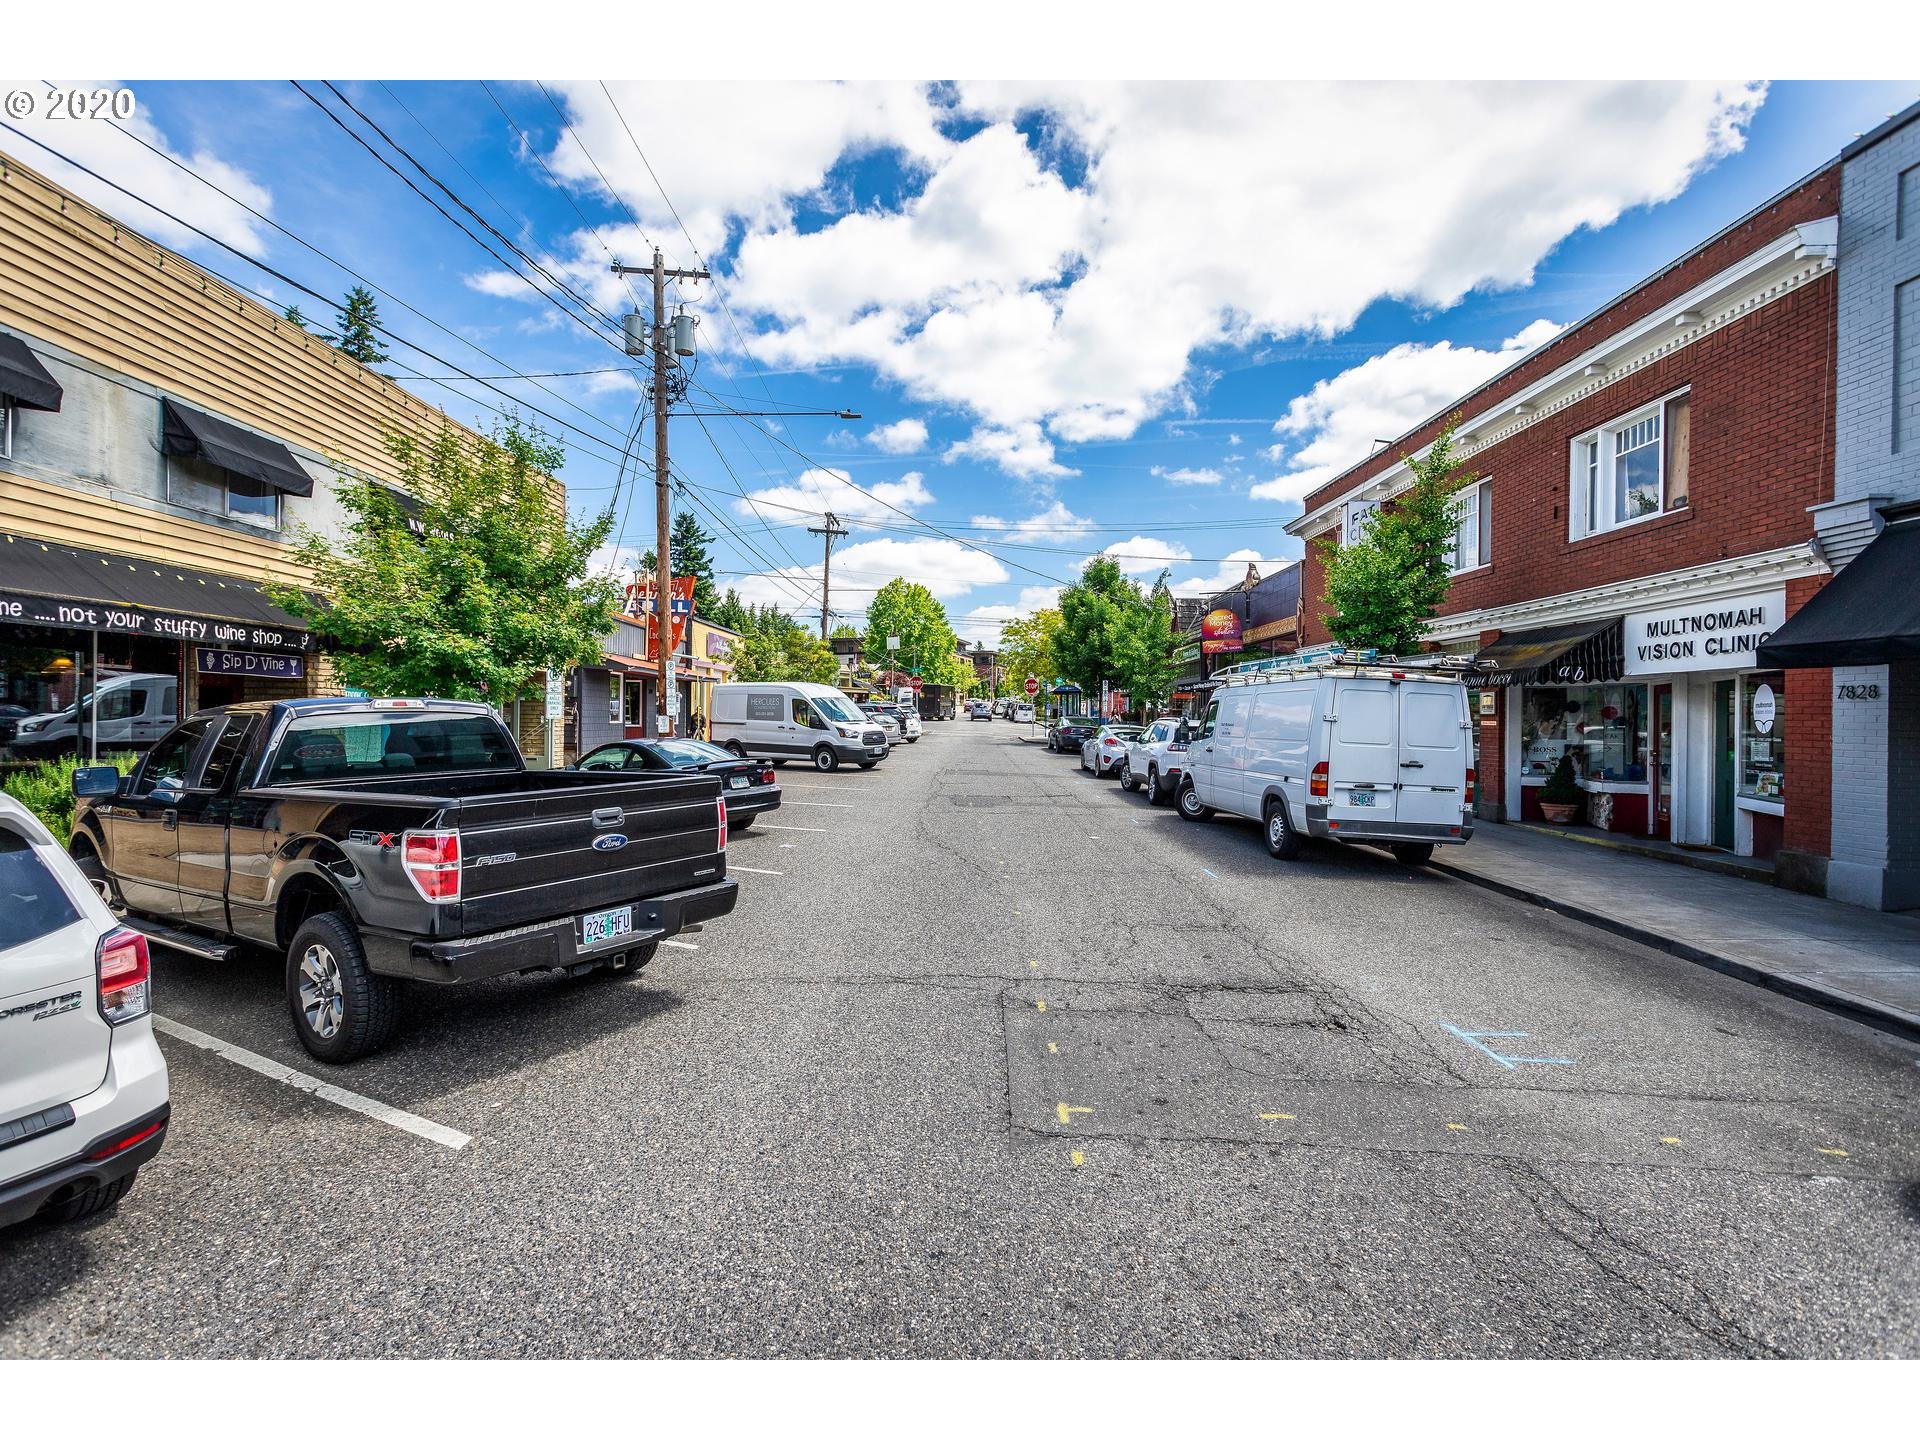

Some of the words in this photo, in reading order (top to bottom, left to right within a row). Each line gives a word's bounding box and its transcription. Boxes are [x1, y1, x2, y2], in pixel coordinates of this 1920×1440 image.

[105, 610, 145, 628] your
[154, 617, 207, 638] stuffy
[214, 624, 246, 641] wine
[1209, 620, 1234, 629] Money
[1646, 606, 1766, 639] MULTNOMAH
[1637, 640, 1697, 662] VISION
[222, 653, 242, 670] Sip
[260, 656, 285, 671] Vine
[1836, 684, 1880, 700] 7828
[349, 829, 396, 847] STX
[601, 838, 622, 848] Ford
[586, 919, 605, 938] 226
[610, 914, 630, 931] HFU
